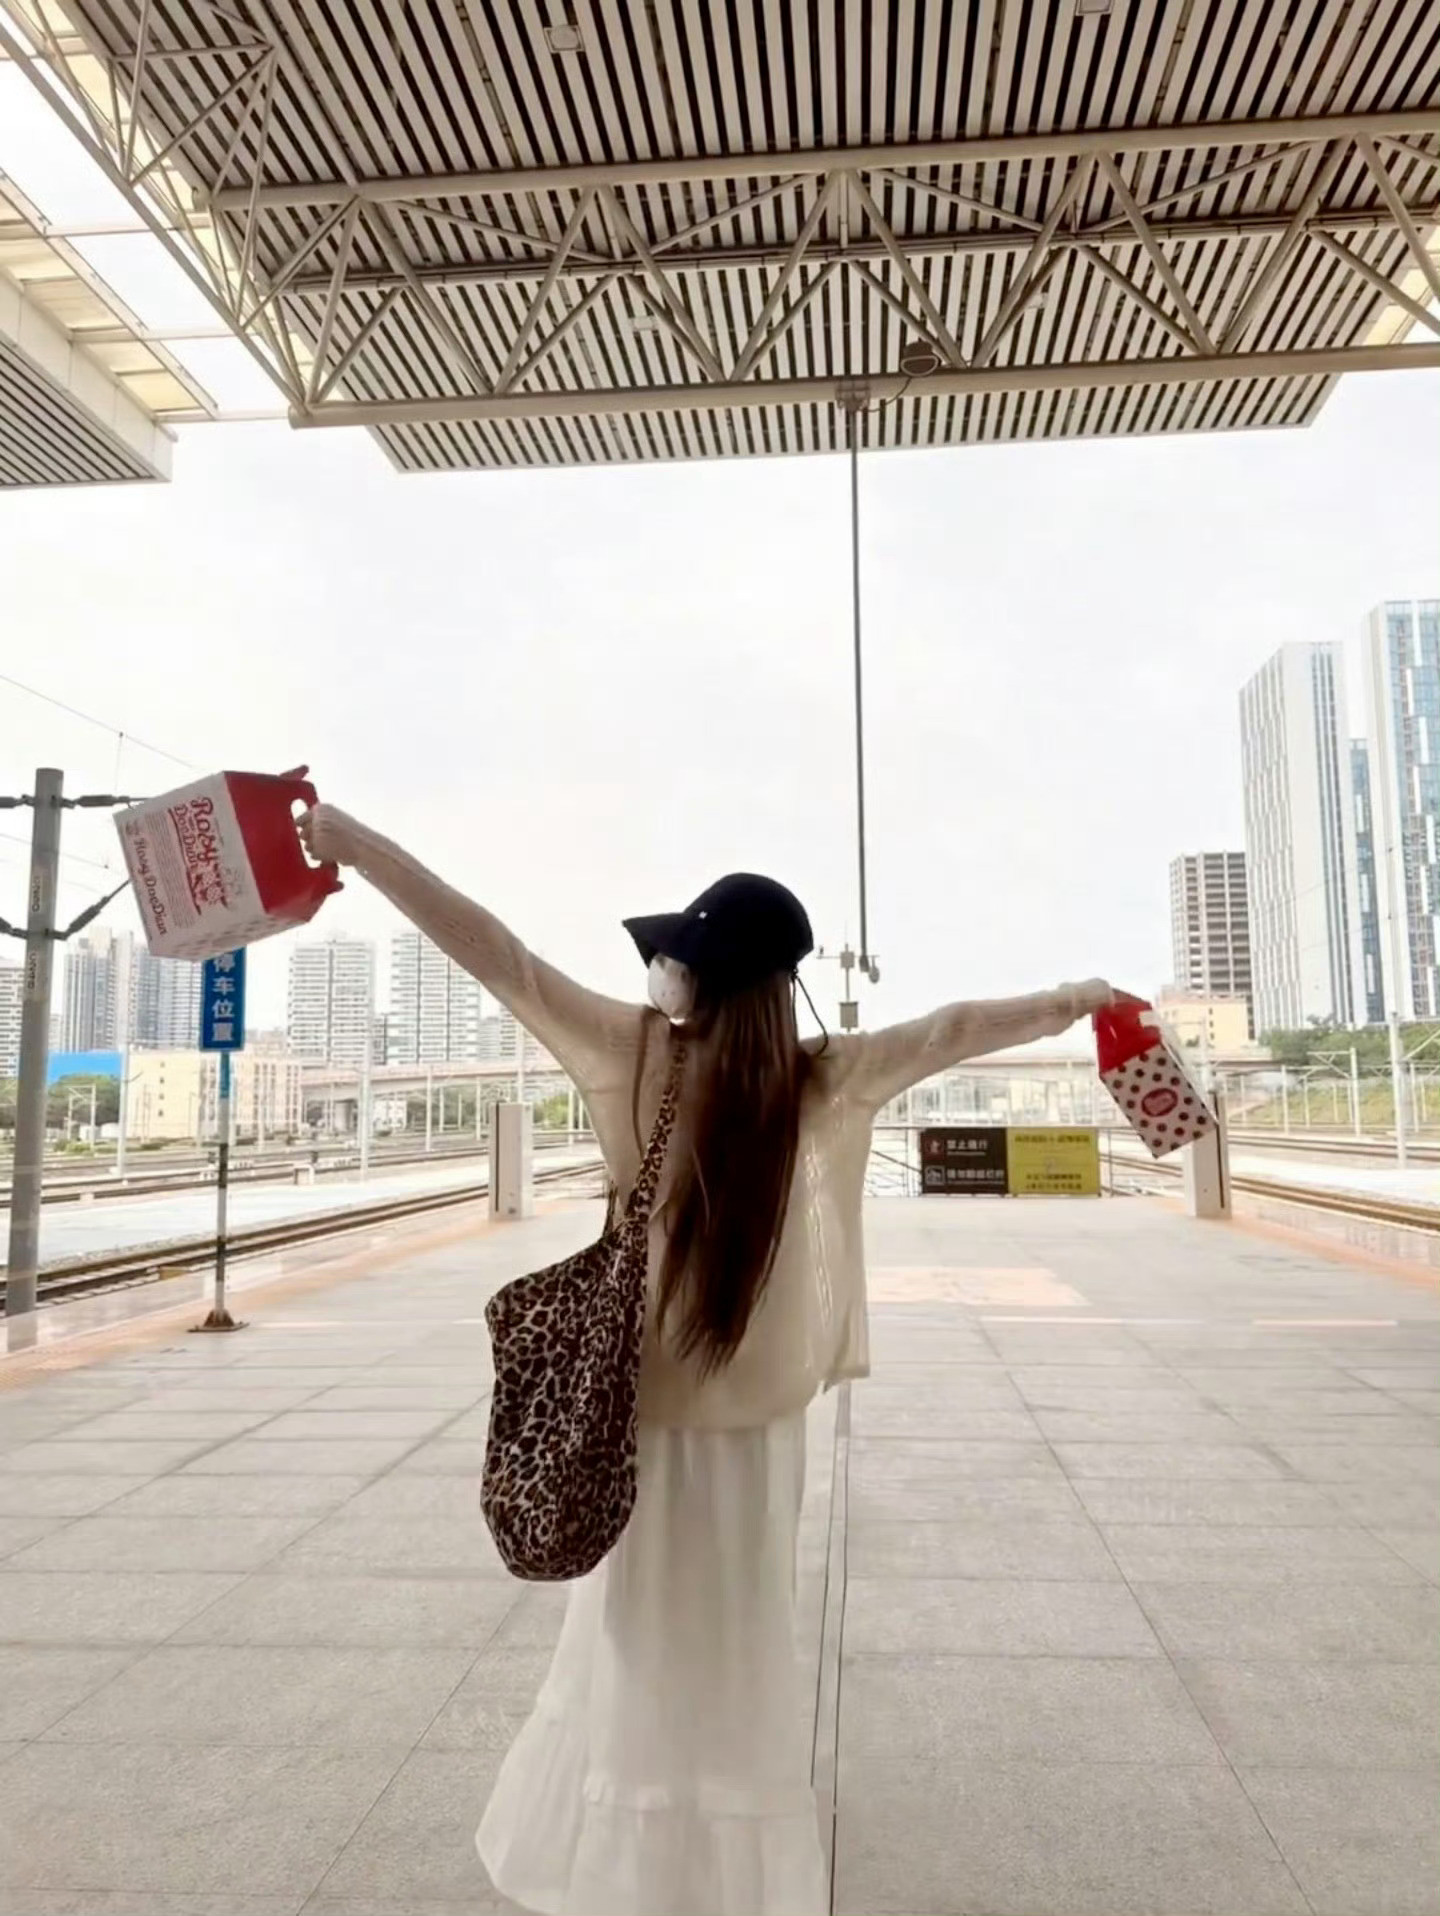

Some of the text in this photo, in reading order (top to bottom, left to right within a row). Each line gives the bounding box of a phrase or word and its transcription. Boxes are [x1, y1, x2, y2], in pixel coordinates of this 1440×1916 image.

[191, 797, 219, 866] Rosy
[212, 953, 235, 1042] 停车位置
